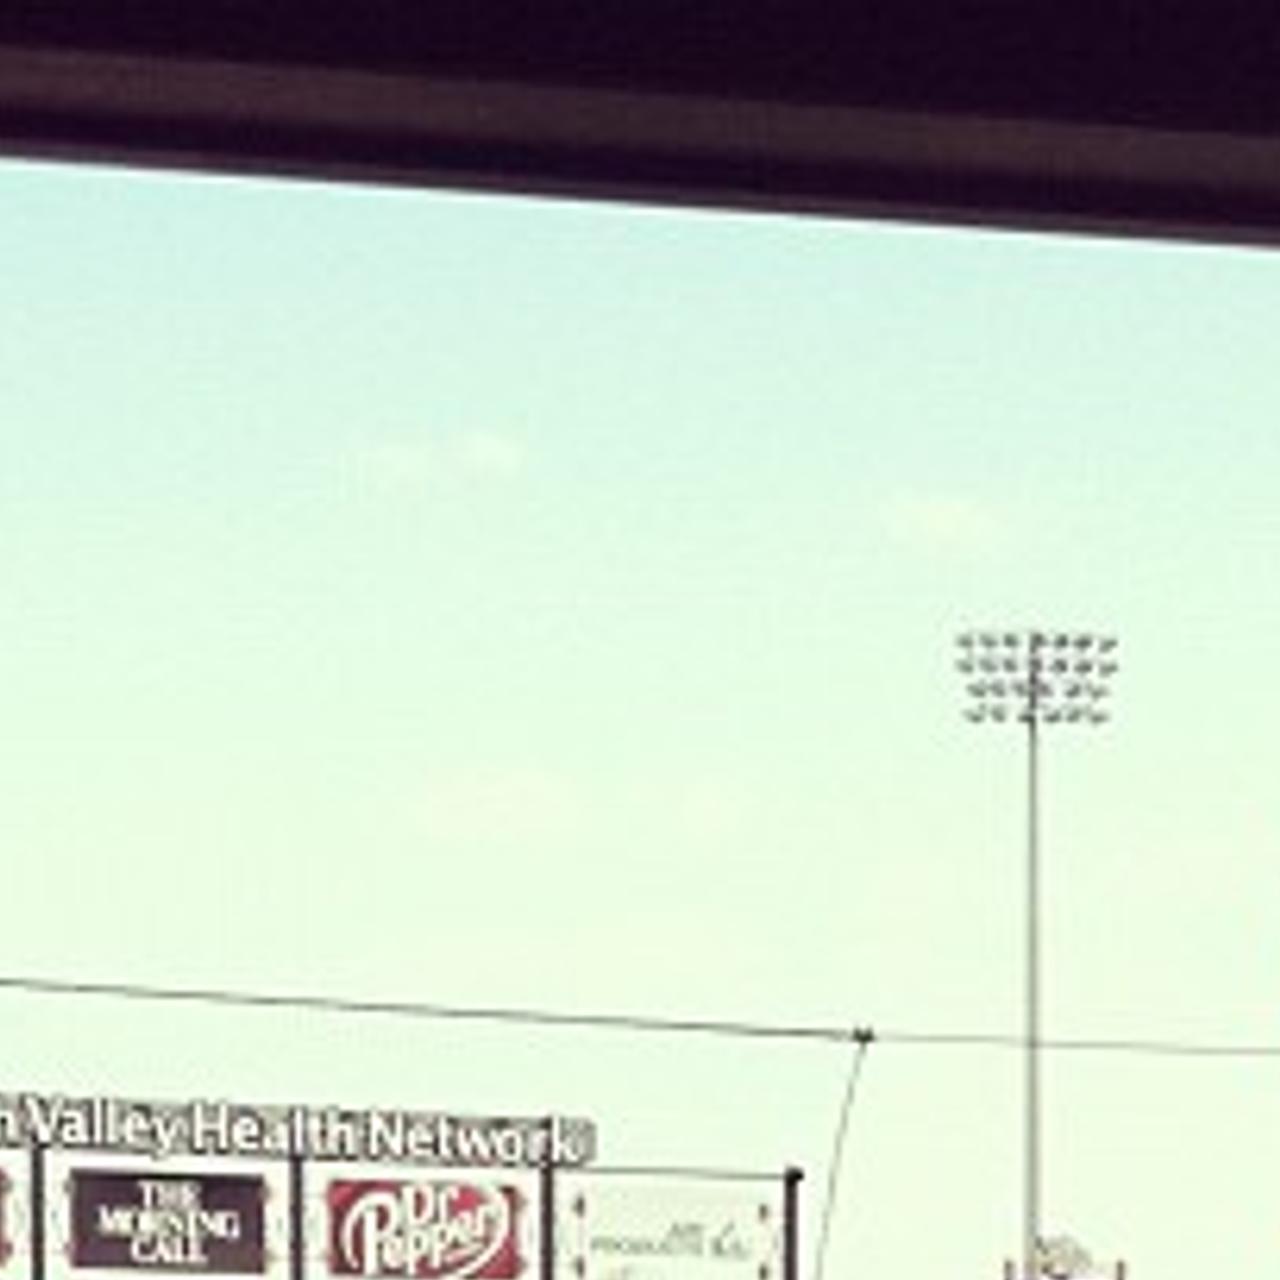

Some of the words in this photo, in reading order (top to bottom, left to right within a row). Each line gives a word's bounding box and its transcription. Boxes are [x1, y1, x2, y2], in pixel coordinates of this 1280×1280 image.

[24, 1096, 178, 1157] Valley
[192, 1101, 357, 1160] Health
[368, 1108, 580, 1165] Network
[136, 1180, 202, 1206] THE
[402, 1184, 461, 1218] Dr
[96, 1206, 240, 1240] MORNING
[361, 1194, 494, 1276] Pepper
[130, 1237, 209, 1264] CALL
